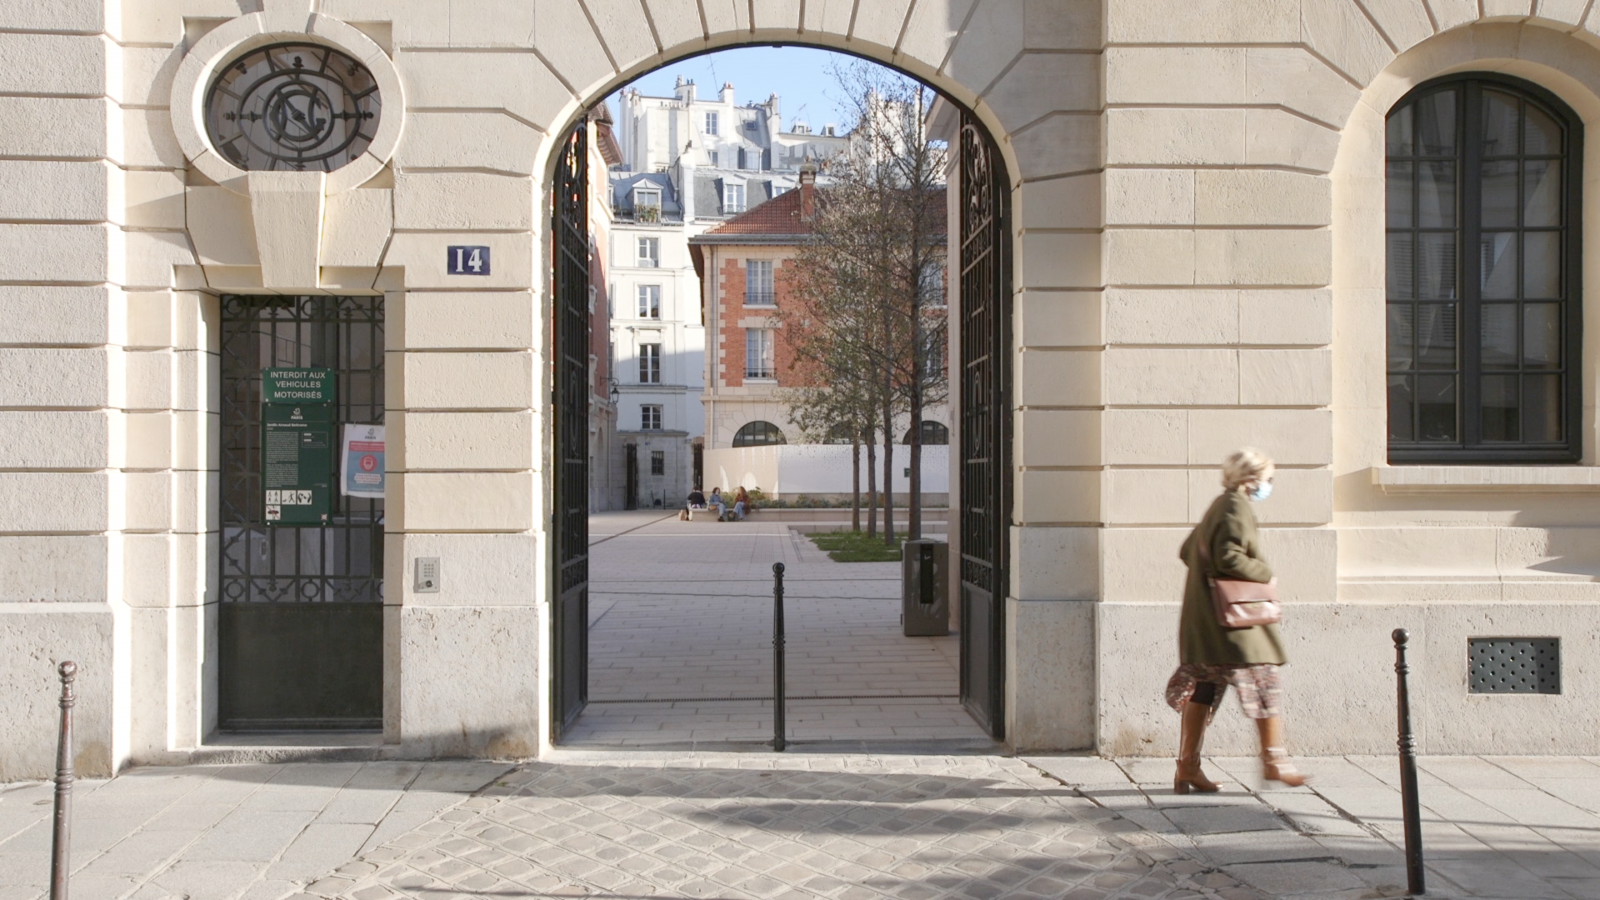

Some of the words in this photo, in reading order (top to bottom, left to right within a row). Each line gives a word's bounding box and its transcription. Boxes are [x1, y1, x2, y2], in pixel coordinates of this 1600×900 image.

[455, 248, 483, 273] 14
[270, 371, 308, 379] INTERDIT
[309, 371, 326, 379] AUX
[275, 380, 321, 388] VEHICULES
[274, 390, 322, 399] MOTORISÉS
